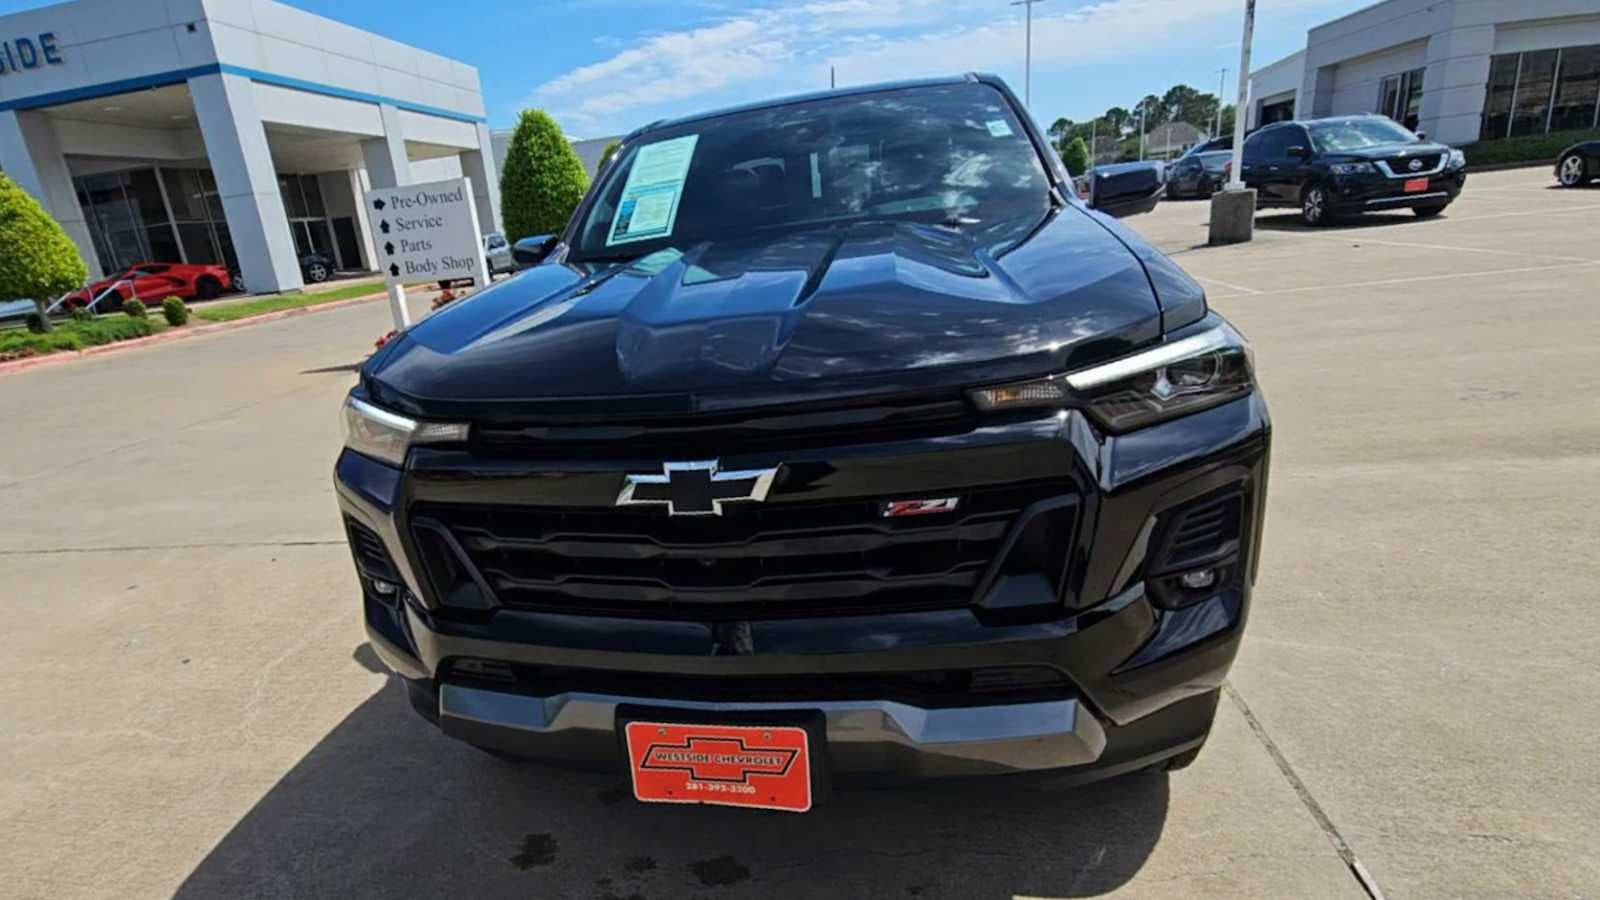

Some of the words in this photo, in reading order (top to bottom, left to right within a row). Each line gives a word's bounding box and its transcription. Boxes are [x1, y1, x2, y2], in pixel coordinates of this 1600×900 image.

[391, 187, 463, 209] Pre-Owned
[396, 215, 442, 231] Service
[401, 239, 432, 253] Parts
[405, 259, 437, 275] Body
[441, 256, 474, 271] Shop
[655, 752, 710, 763] WESTSIDE
[714, 755, 782, 766] CHEVROLET
